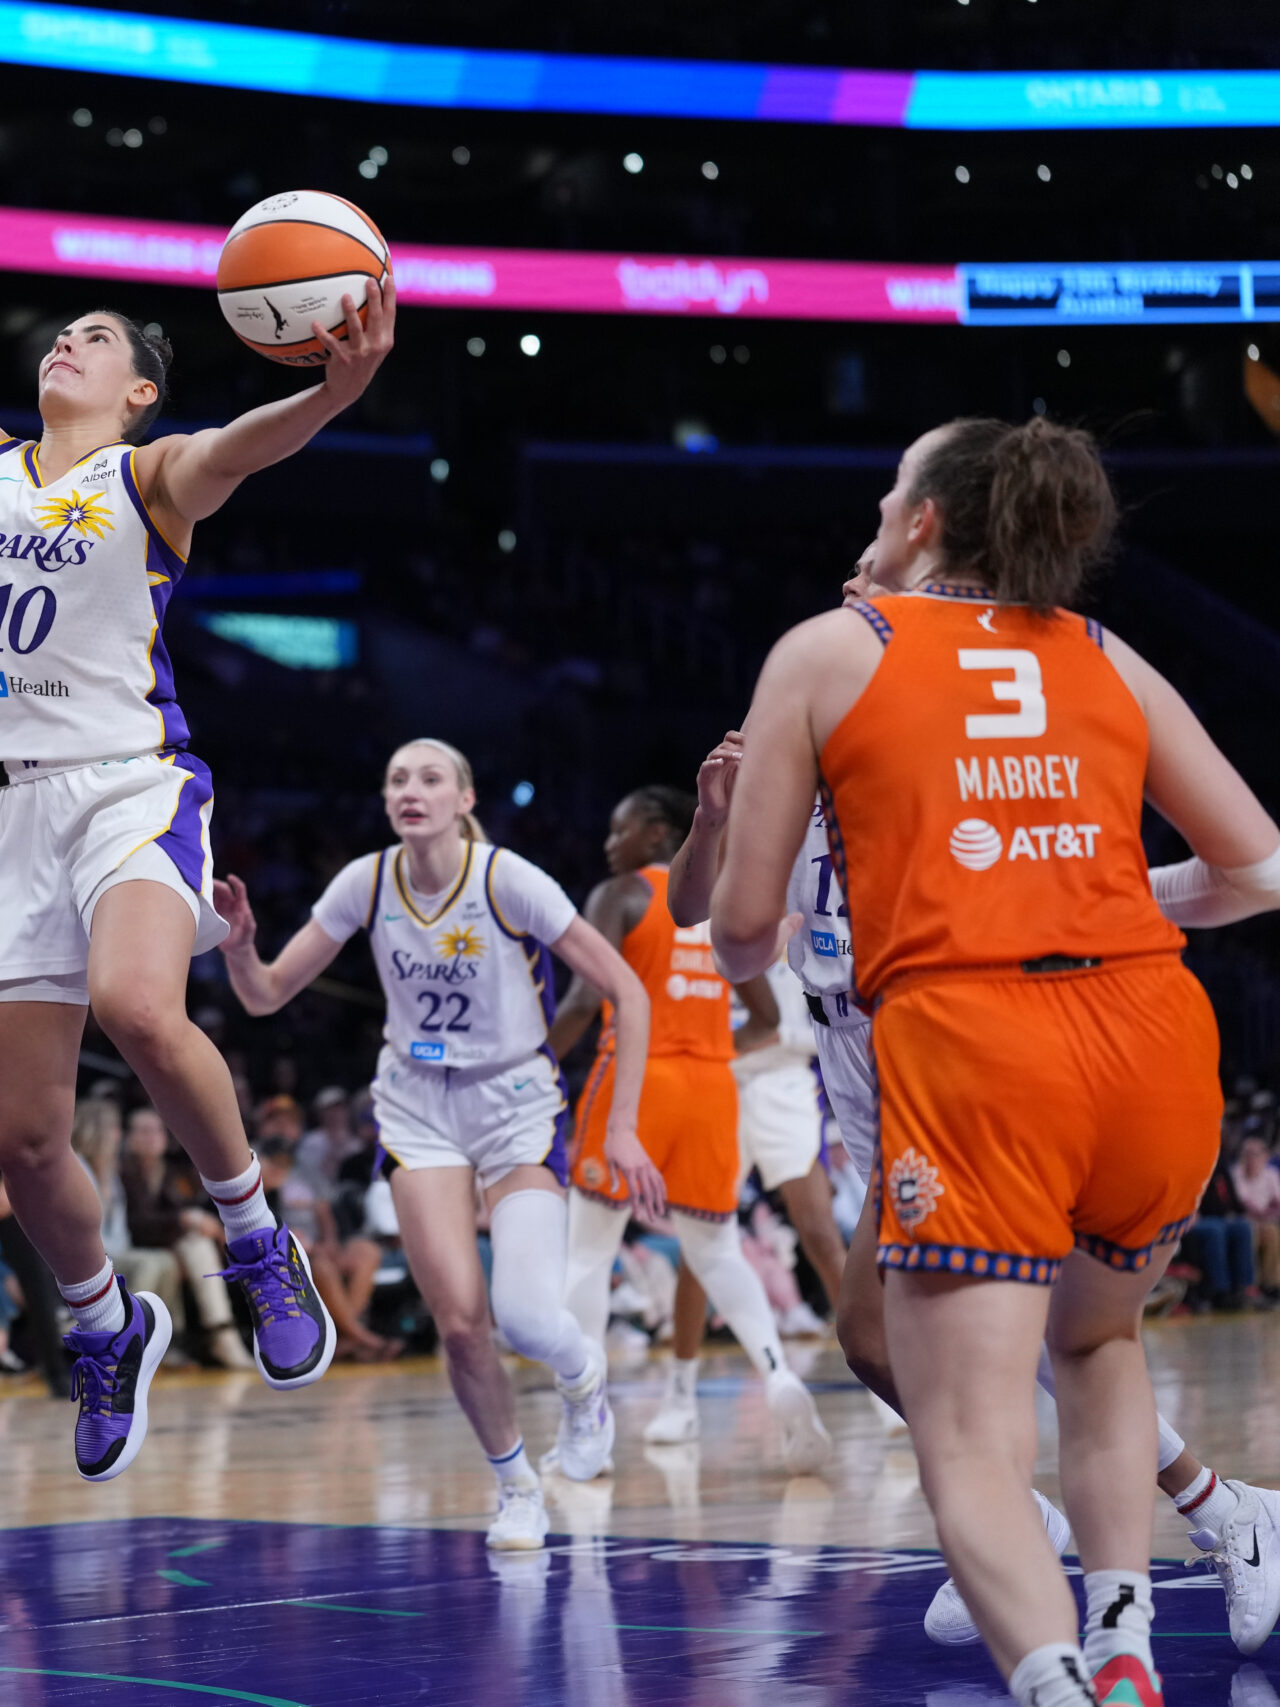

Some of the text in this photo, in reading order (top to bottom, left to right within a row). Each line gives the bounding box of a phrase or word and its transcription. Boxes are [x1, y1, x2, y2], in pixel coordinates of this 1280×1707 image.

[52, 227, 194, 273] WIRELESS
[616, 257, 769, 313] boldyn
[81, 469, 117, 485] Albert
[9, 676, 70, 697] Health
[957, 648, 1048, 739] 3
[955, 754, 1080, 802] MABREY
[1007, 822, 1102, 861] AT&T
[813, 935, 835, 952] UCLA
[417, 991, 472, 1033] 22
[413, 1045, 442, 1058] UCLA
